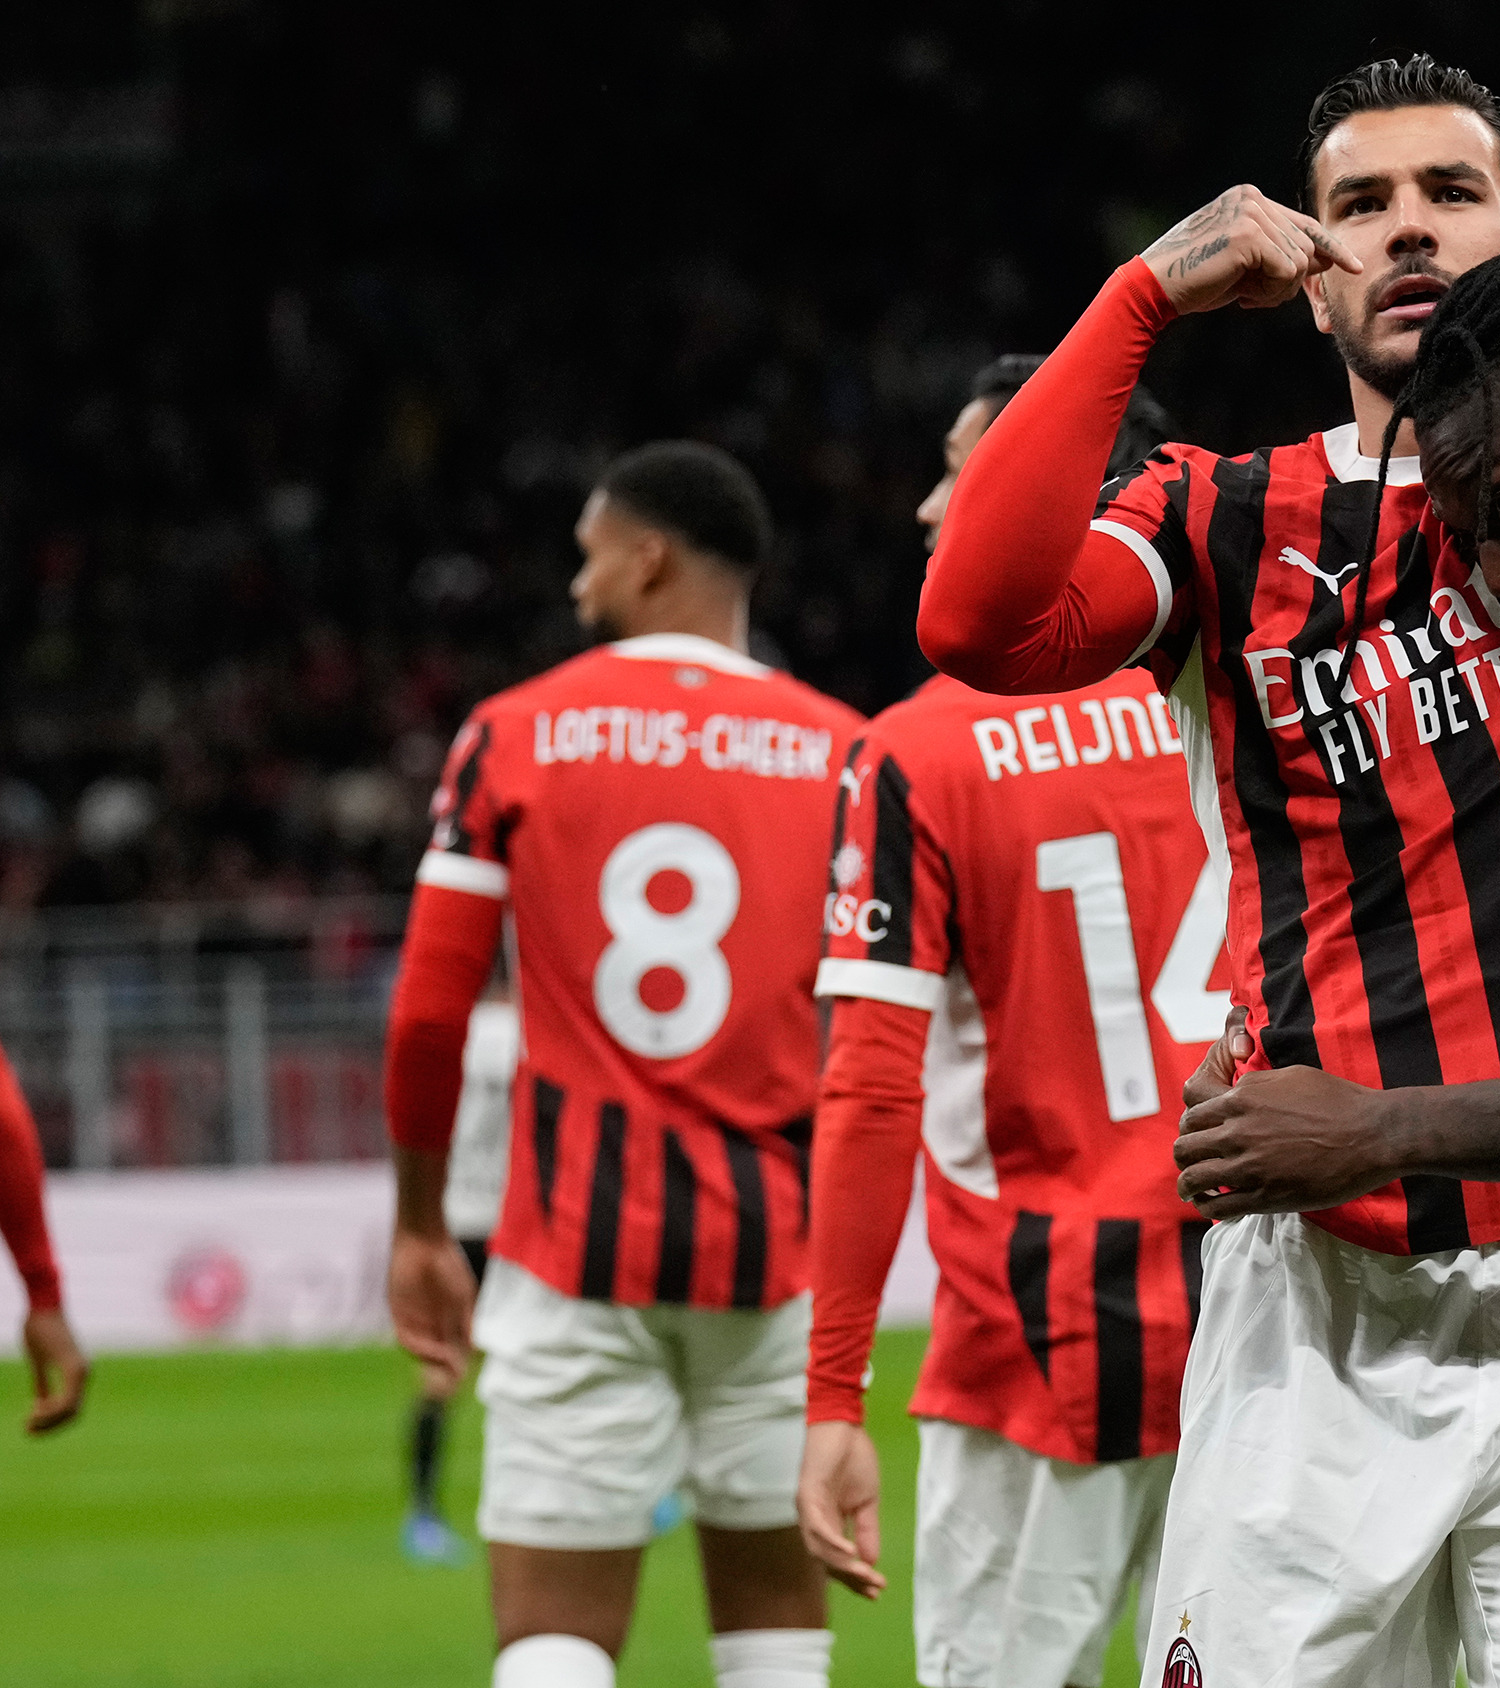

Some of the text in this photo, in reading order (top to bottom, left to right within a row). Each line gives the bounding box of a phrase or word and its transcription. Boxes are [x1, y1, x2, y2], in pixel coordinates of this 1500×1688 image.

[534, 706, 832, 781] LOFTUS-CHEEK
[1319, 693, 1391, 785] FLY
[593, 821, 741, 1060] 8
[1037, 831, 1232, 1122] 14
